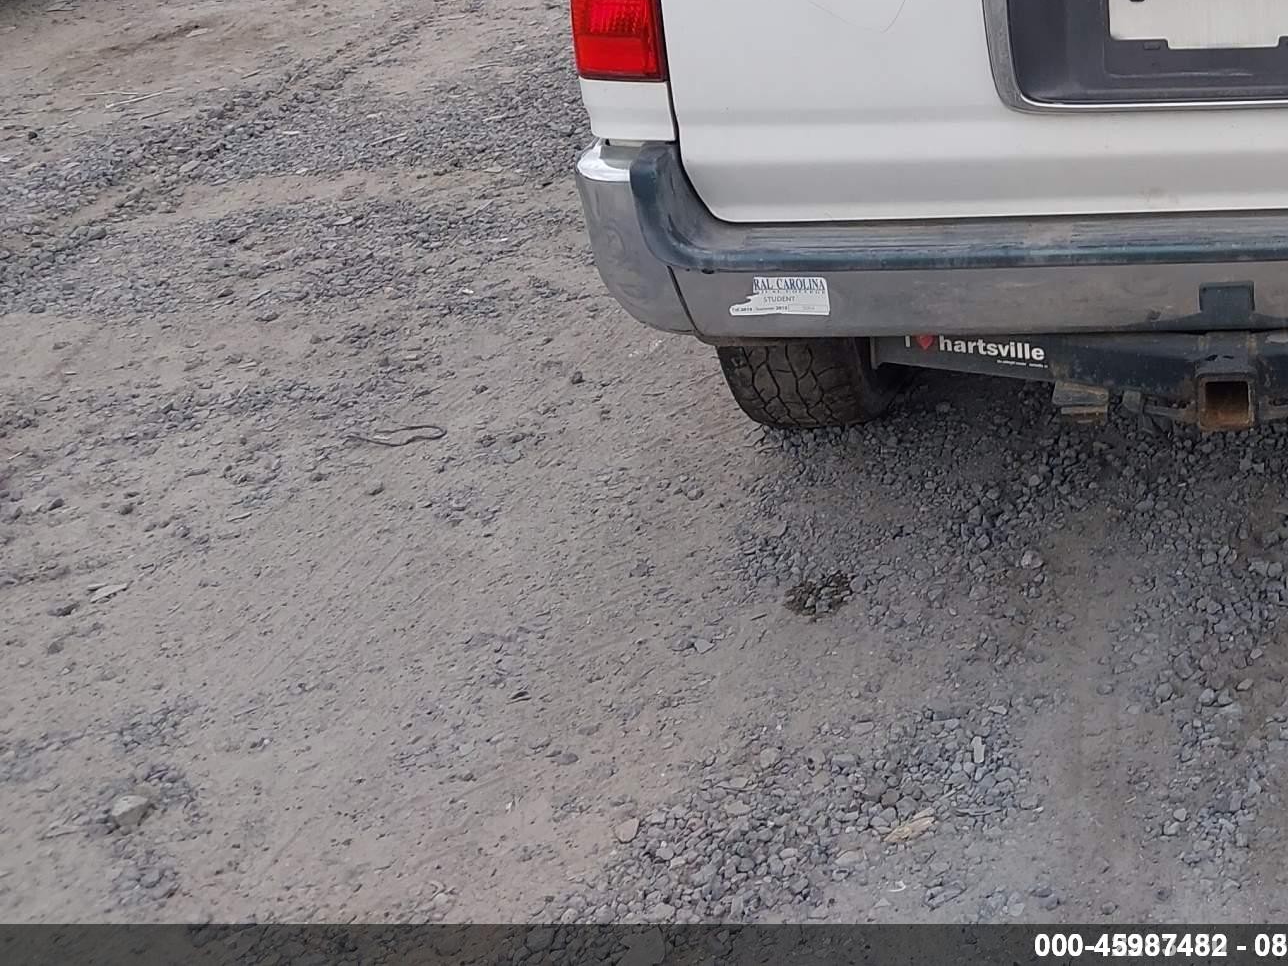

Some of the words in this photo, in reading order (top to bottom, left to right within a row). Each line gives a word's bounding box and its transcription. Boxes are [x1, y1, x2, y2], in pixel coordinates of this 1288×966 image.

[776, 278, 826, 291] CAROLINA
[763, 295, 796, 303] STUDENT
[939, 335, 1045, 360] hartsville
